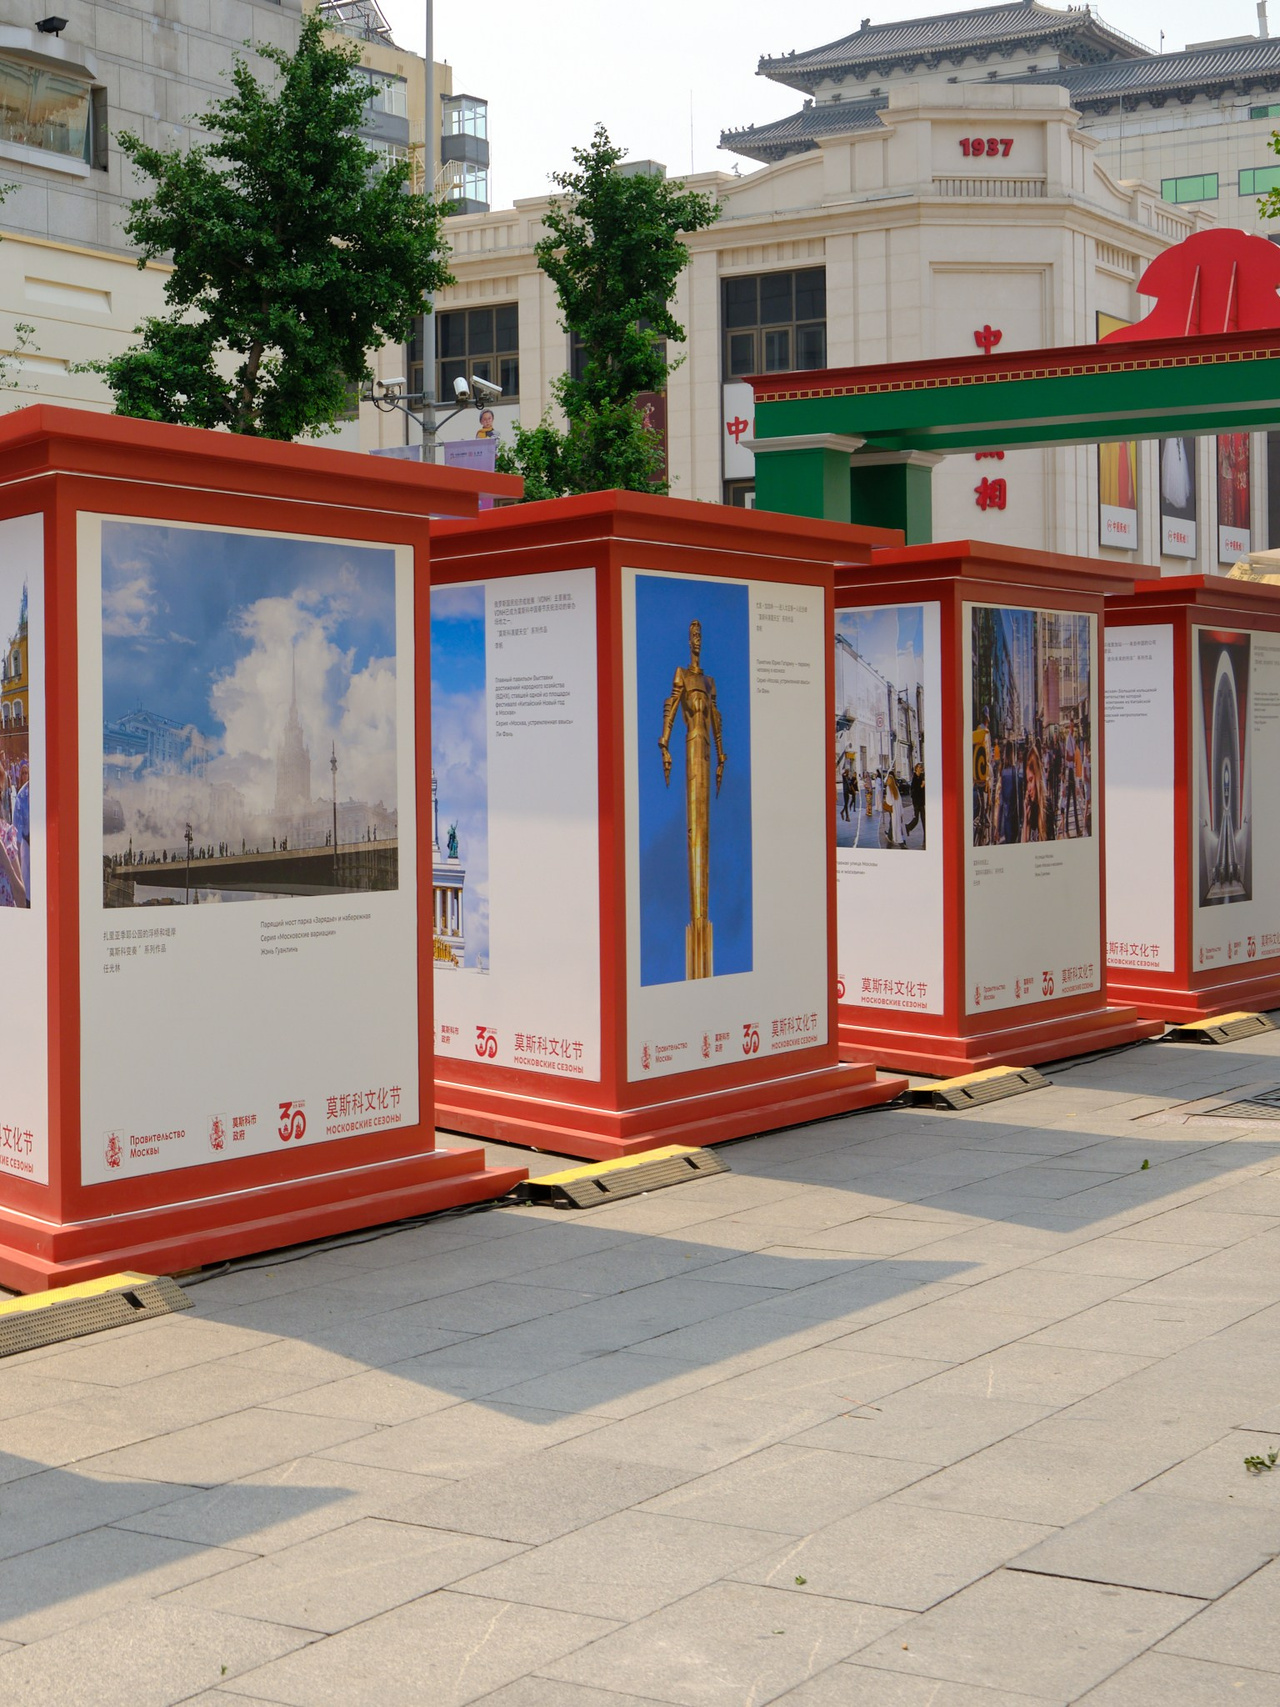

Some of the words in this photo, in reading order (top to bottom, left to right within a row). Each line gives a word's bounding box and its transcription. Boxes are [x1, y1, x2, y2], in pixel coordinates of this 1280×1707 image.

[959, 138, 1014, 157] 1937
[261, 920, 284, 928] Парящий
[261, 934, 276, 942] Серия
[1106, 941, 1160, 958] 斯科文化节
[1062, 964, 1094, 983] 莫斯科文化节
[862, 977, 928, 998] 莫斯科文化节
[861, 996, 901, 1007] МОСКОВСКИЕ
[902, 1000, 928, 1009] СЕЗОНЫ
[441, 1025, 459, 1035] 莫斯科市
[772, 1012, 818, 1038] 莫斯科文化节
[441, 1035, 450, 1044] 政府
[514, 1032, 584, 1060] 莫斯科文化节
[772, 1038, 799, 1050] МОСКОВСКИЕ
[800, 1034, 818, 1045] СЕЗОНЫ
[655, 1042, 688, 1053] Правительство
[514, 1056, 556, 1069] МОСКОВСКИЕ
[557, 1061, 584, 1074] СЕЗОНЫ
[655, 1054, 673, 1063] Москвы
[326, 1086, 402, 1120] 莫斯科文化节
[232, 1114, 257, 1129] 莫斯科市
[326, 1119, 373, 1135] МОСКОВСКИЕ
[373, 1113, 402, 1128] СЕЗОНЫ
[130, 1130, 186, 1147] Правительство
[232, 1129, 245, 1142] 政府
[130, 1147, 160, 1158] Москвы
[10, 1159, 34, 1173] СЕЗОНЫ
